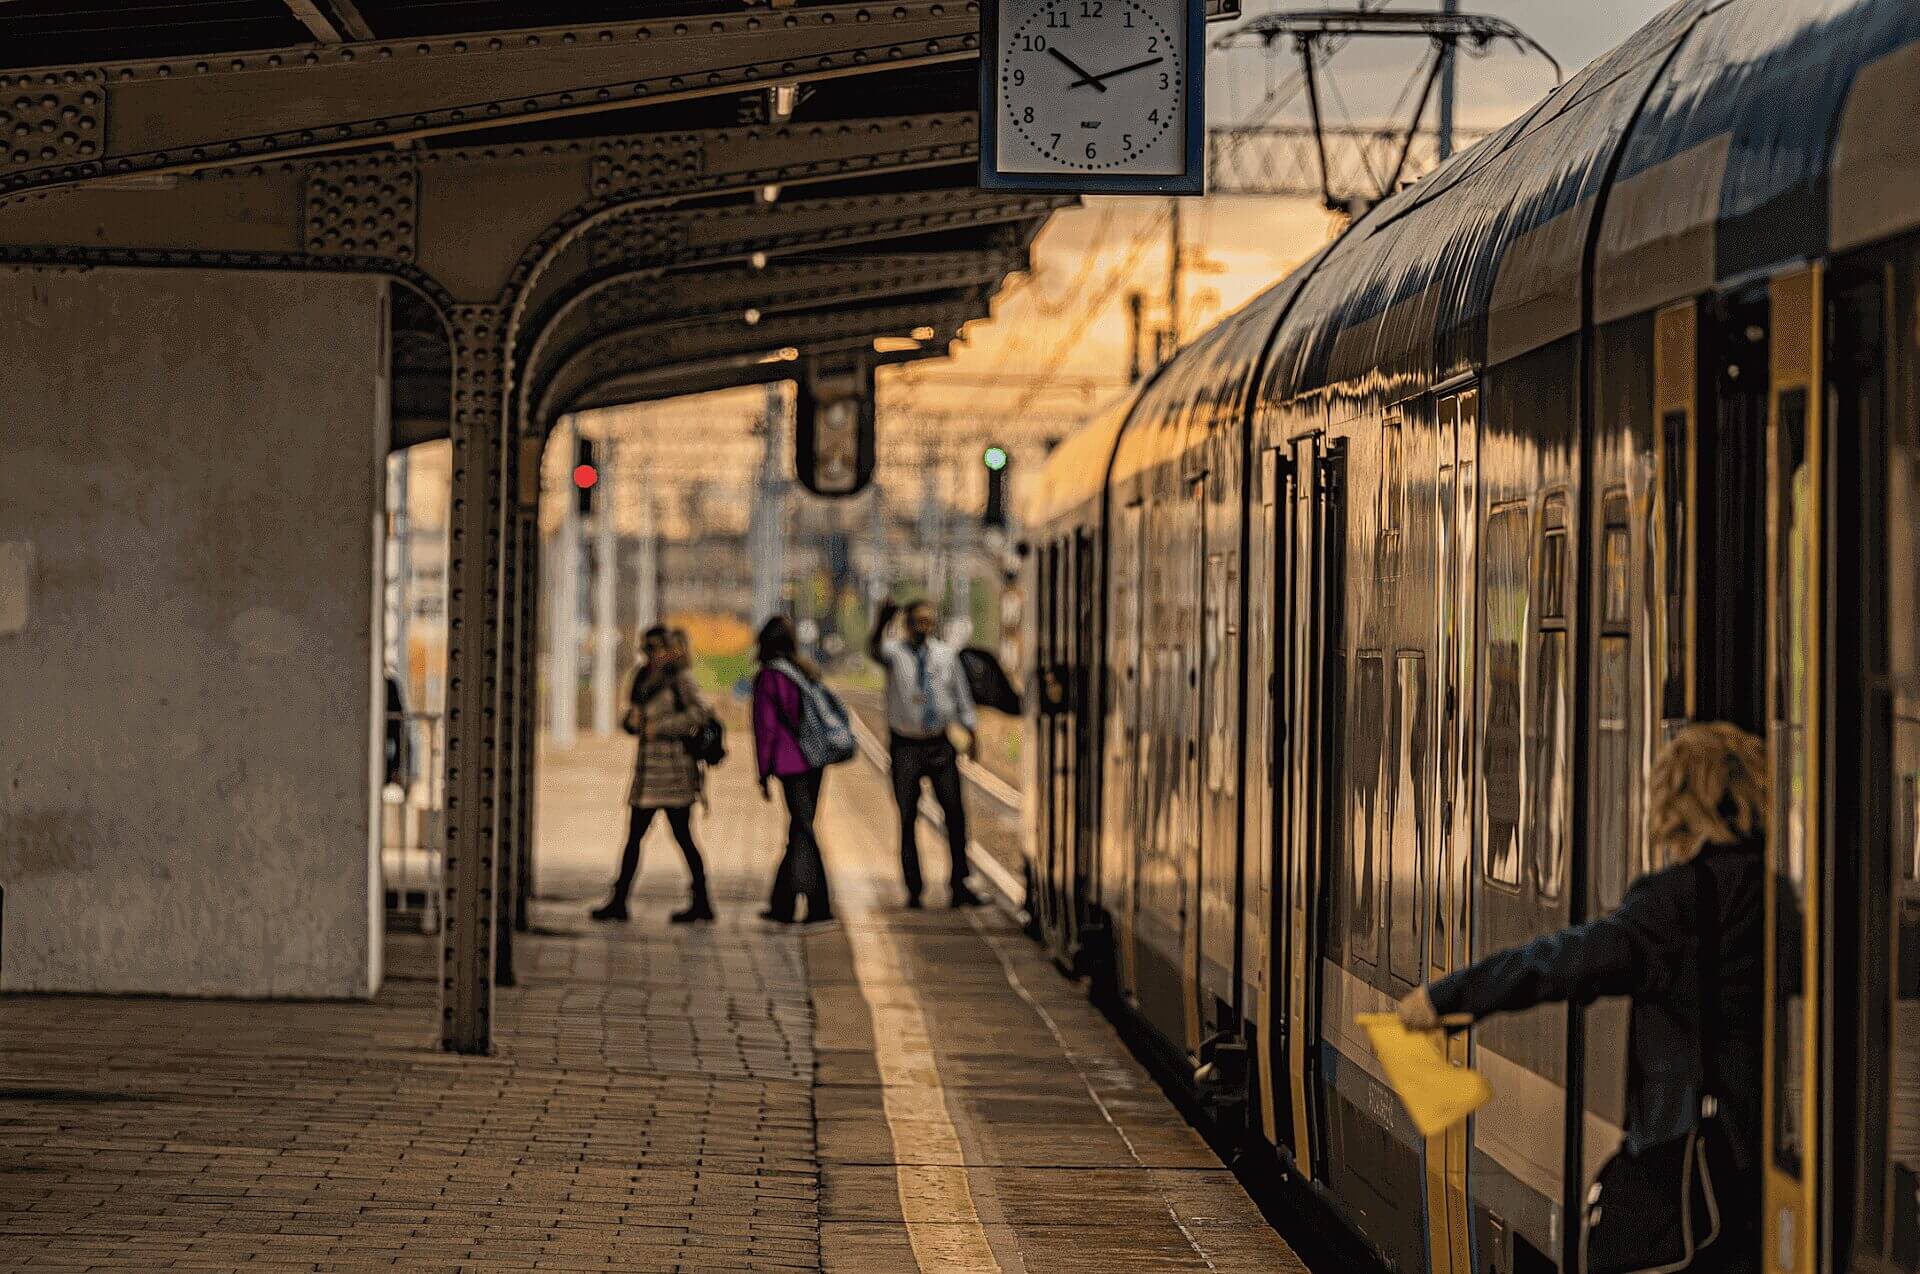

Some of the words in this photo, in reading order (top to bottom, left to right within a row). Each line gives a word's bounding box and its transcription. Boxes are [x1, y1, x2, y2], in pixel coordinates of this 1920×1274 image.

[1080, 1, 1103, 18] 12
[1046, 11, 1071, 28] 11
[1122, 11, 1135, 28] 1
[1022, 35, 1046, 52] 10
[1148, 36, 1157, 53] 2
[1013, 69, 1025, 87] 9
[1159, 73, 1169, 90] 3
[1023, 107, 1034, 123] 8
[1148, 109, 1159, 125] 4
[1050, 133, 1061, 150] 7
[1122, 134, 1132, 151] 5
[1086, 142, 1096, 159] 6
